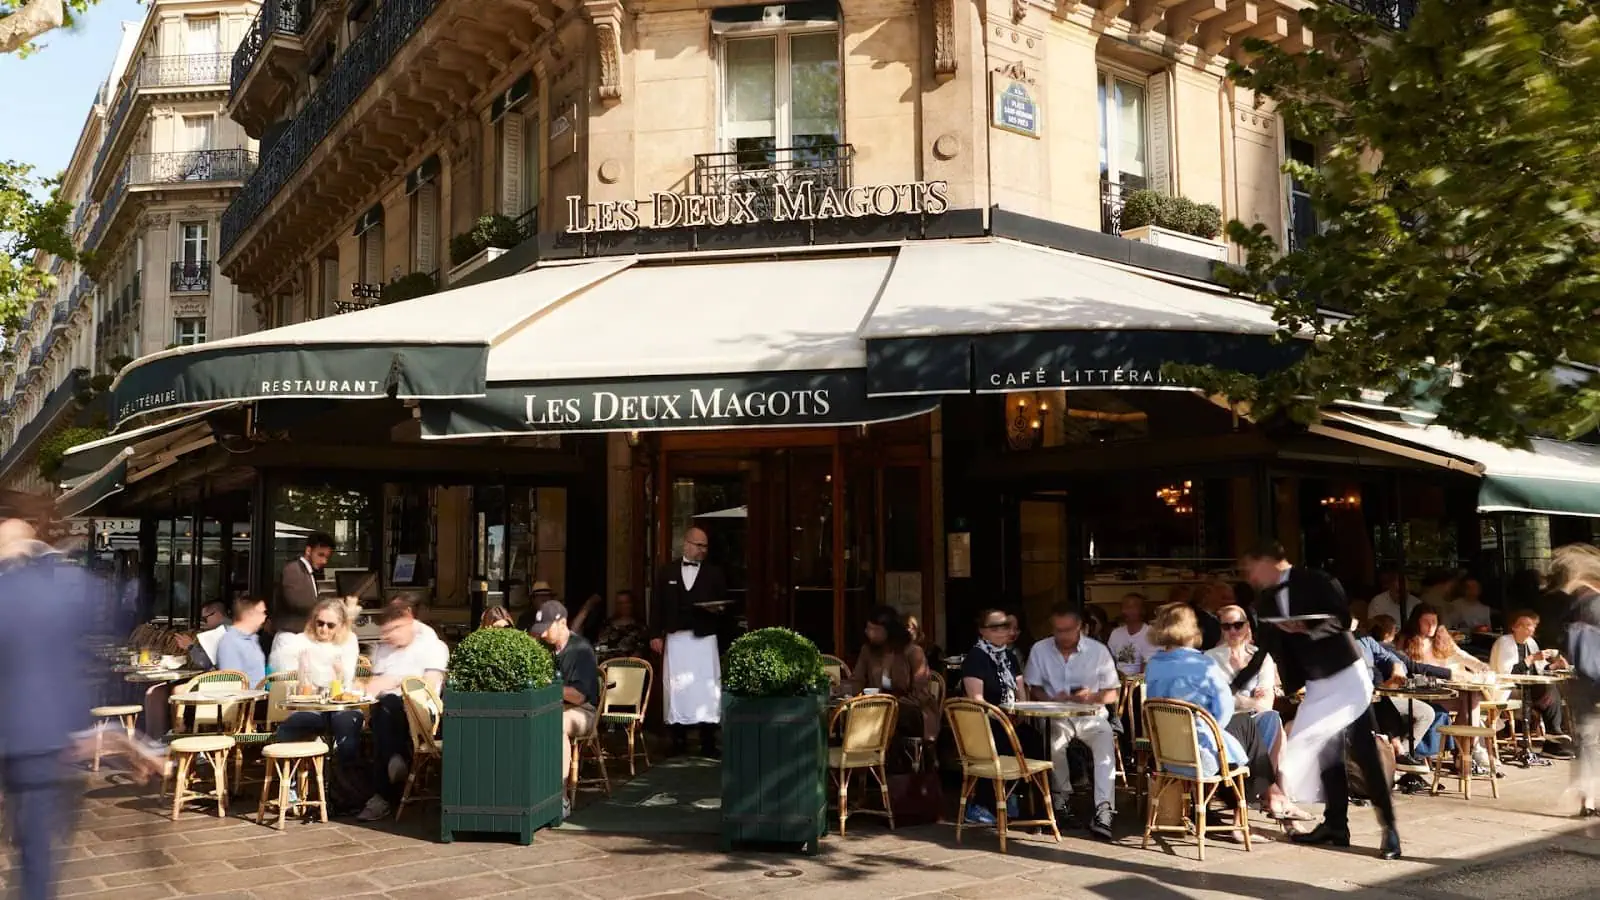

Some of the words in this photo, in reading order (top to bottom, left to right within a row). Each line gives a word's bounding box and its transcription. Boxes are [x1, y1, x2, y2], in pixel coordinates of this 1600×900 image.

[566, 195, 639, 233] LES
[650, 190, 757, 227] DEUX
[773, 180, 949, 219] MAGOTS
[261, 380, 379, 393] RESTAURANT
[990, 367, 1046, 385] CAFÉ
[1060, 366, 1176, 384] LITTÉRAI
[524, 394, 581, 424] LES
[592, 391, 681, 422] DEUX
[689, 388, 831, 418] MAGOTS
